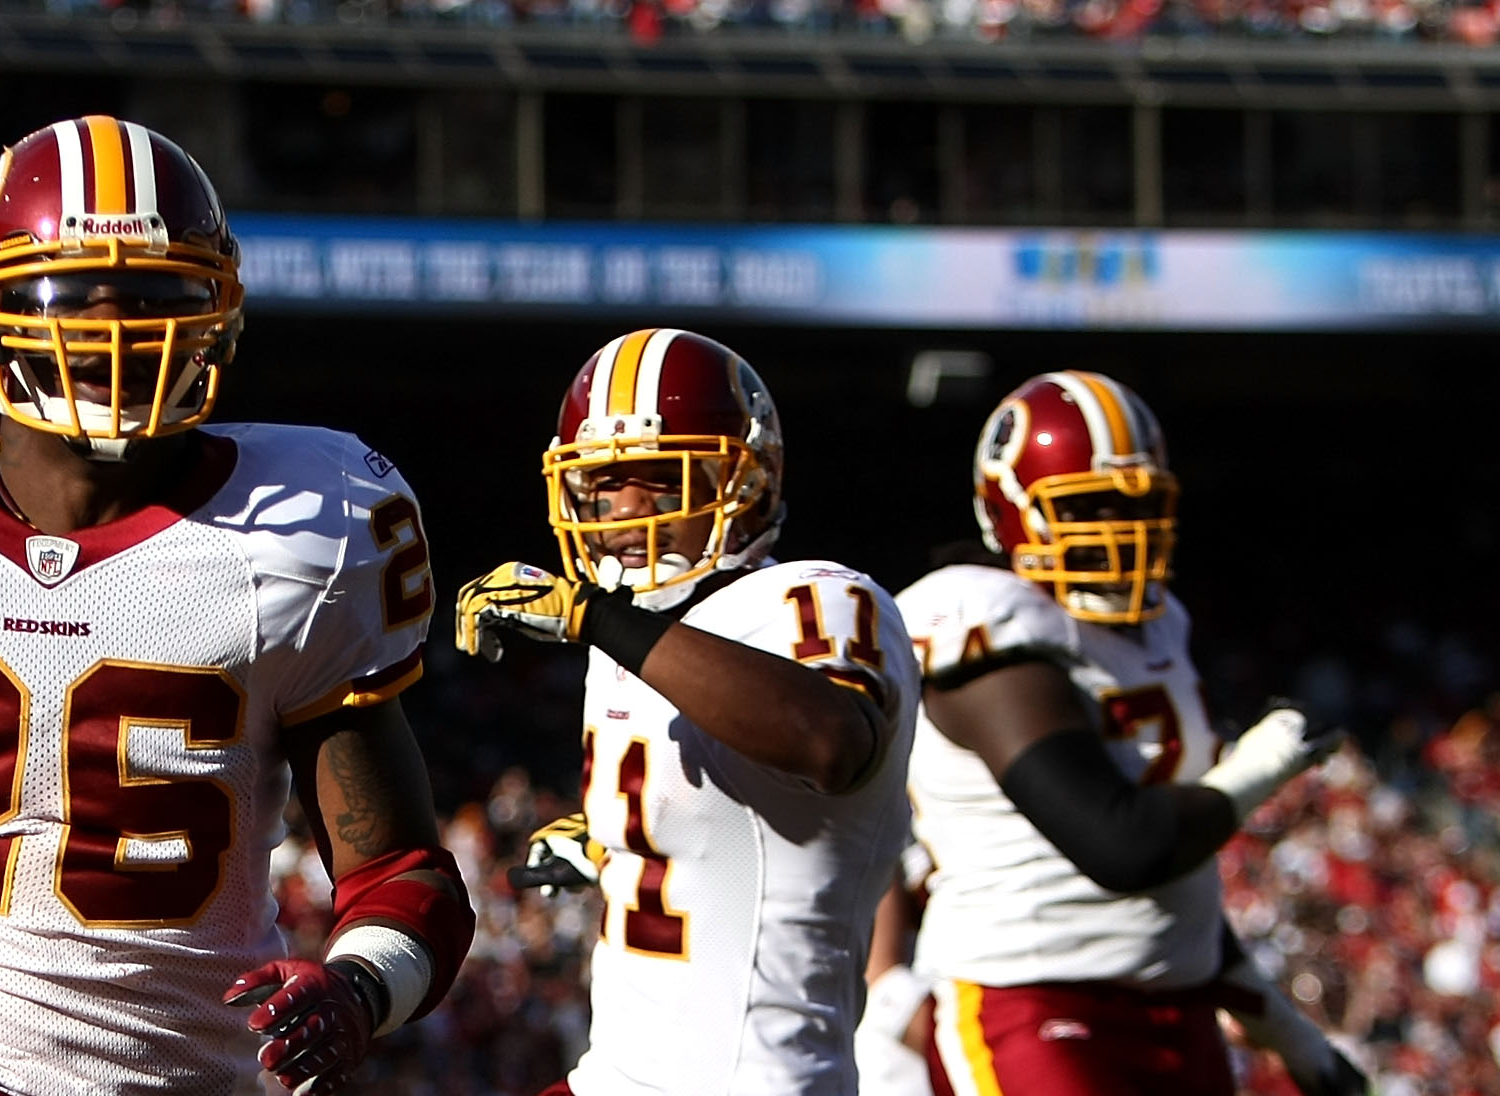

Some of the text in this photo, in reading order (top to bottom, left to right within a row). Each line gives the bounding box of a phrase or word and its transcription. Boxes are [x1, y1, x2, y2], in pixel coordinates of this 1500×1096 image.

[40, 559, 61, 575] NFL
[3, 617, 92, 637] REDSKINS
[783, 582, 885, 671] 11
